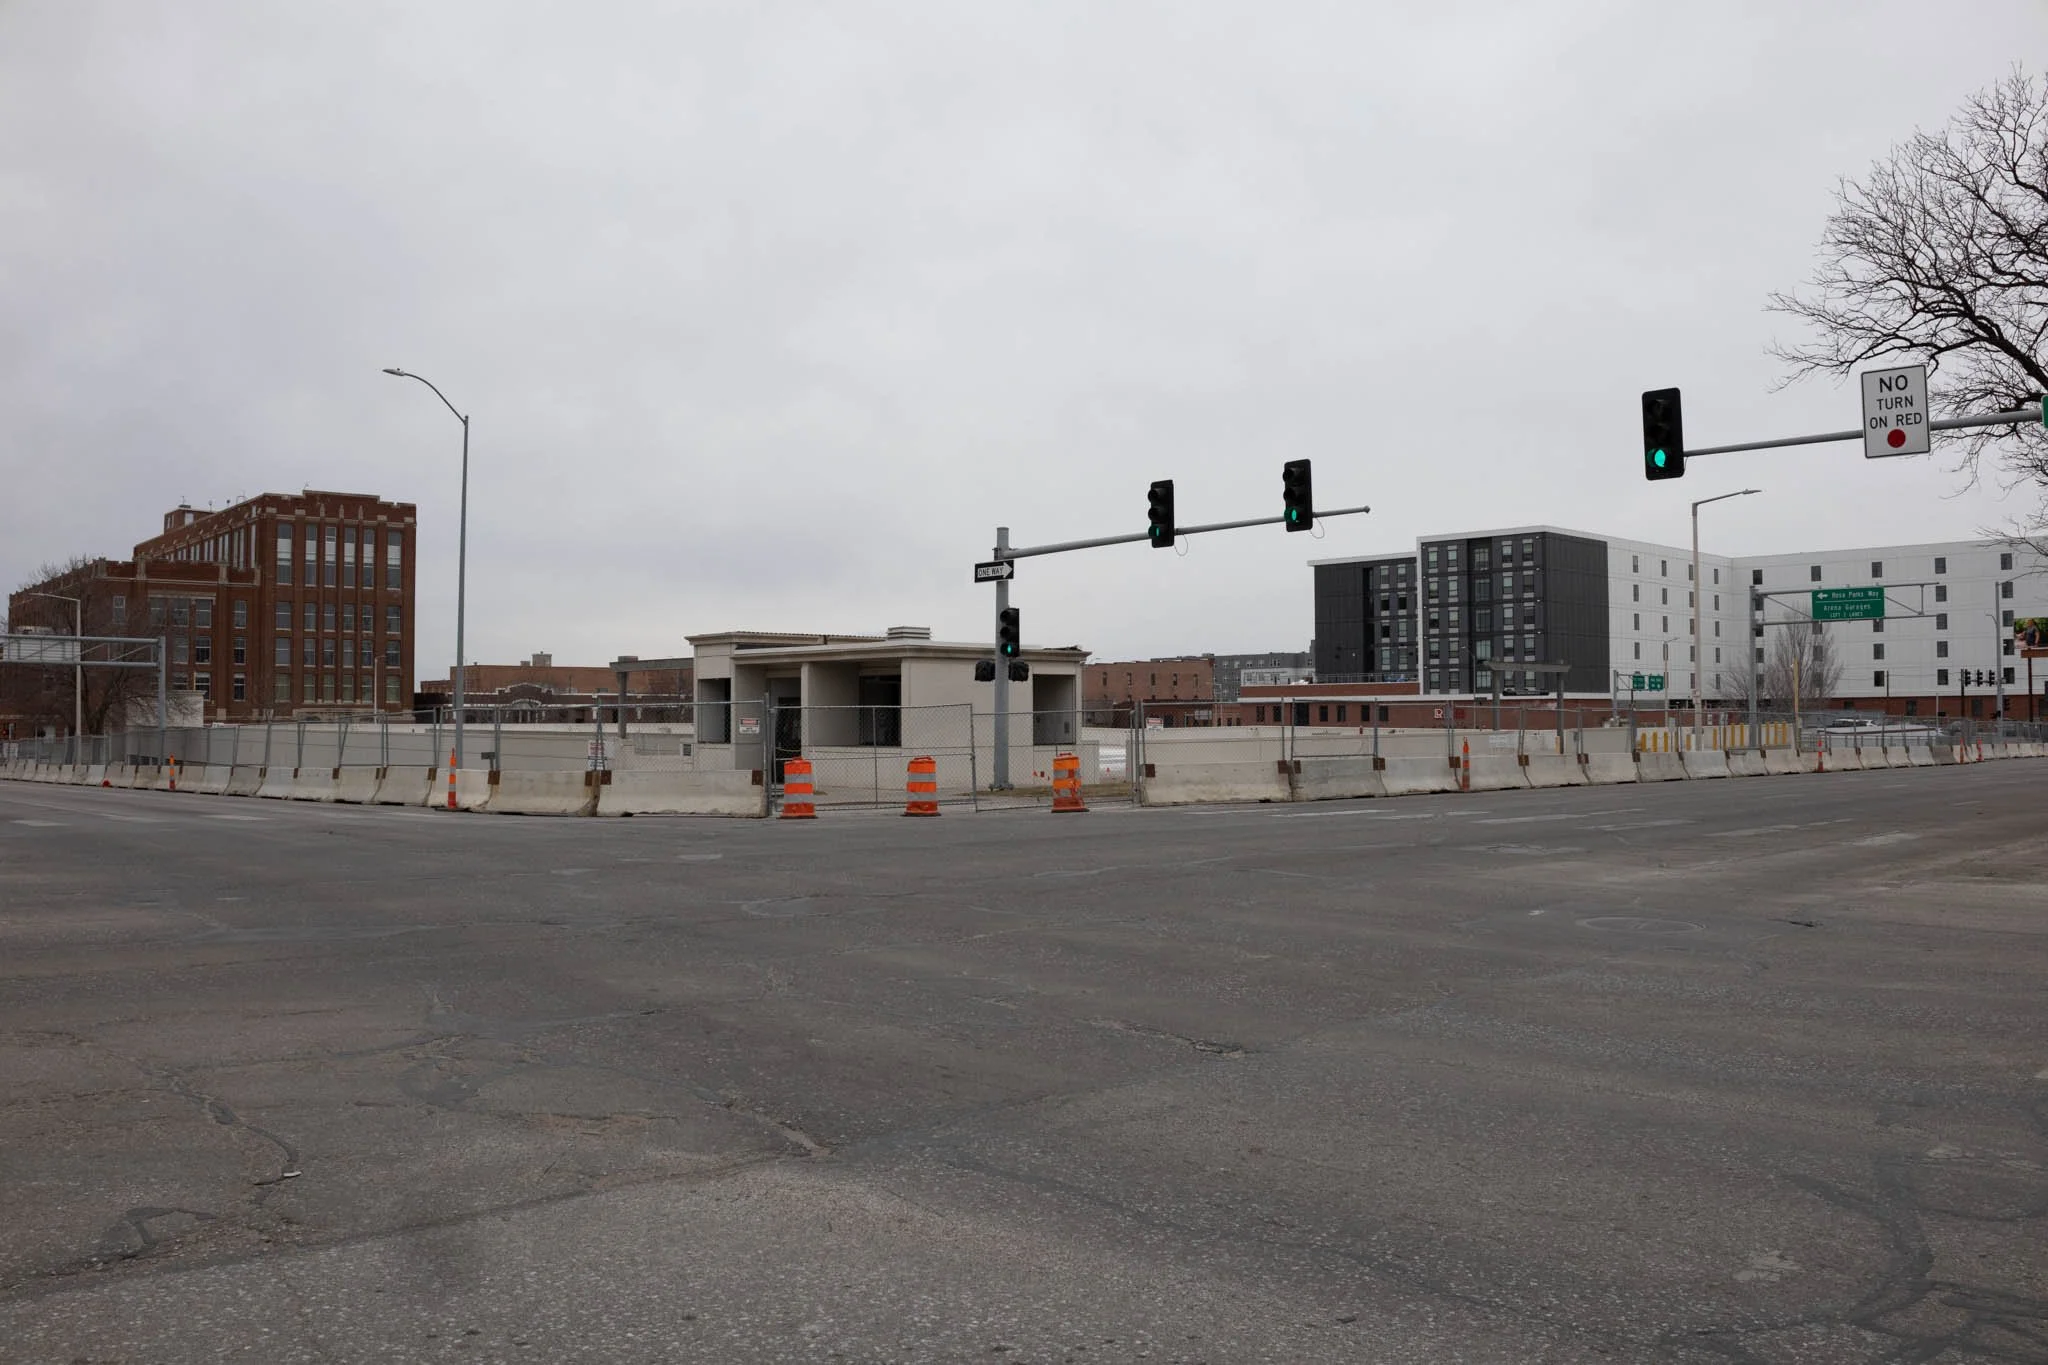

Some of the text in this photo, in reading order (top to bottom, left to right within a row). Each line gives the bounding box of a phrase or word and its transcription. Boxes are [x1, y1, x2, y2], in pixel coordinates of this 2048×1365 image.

[1880, 374, 1908, 393] NO
[1876, 395, 1914, 411] TURN
[1869, 412, 1922, 429] ON RED
[978, 566, 1003, 577] ONE WAY
[1867, 590, 1879, 599] Way
[1823, 603, 1871, 612] Arena Garages
